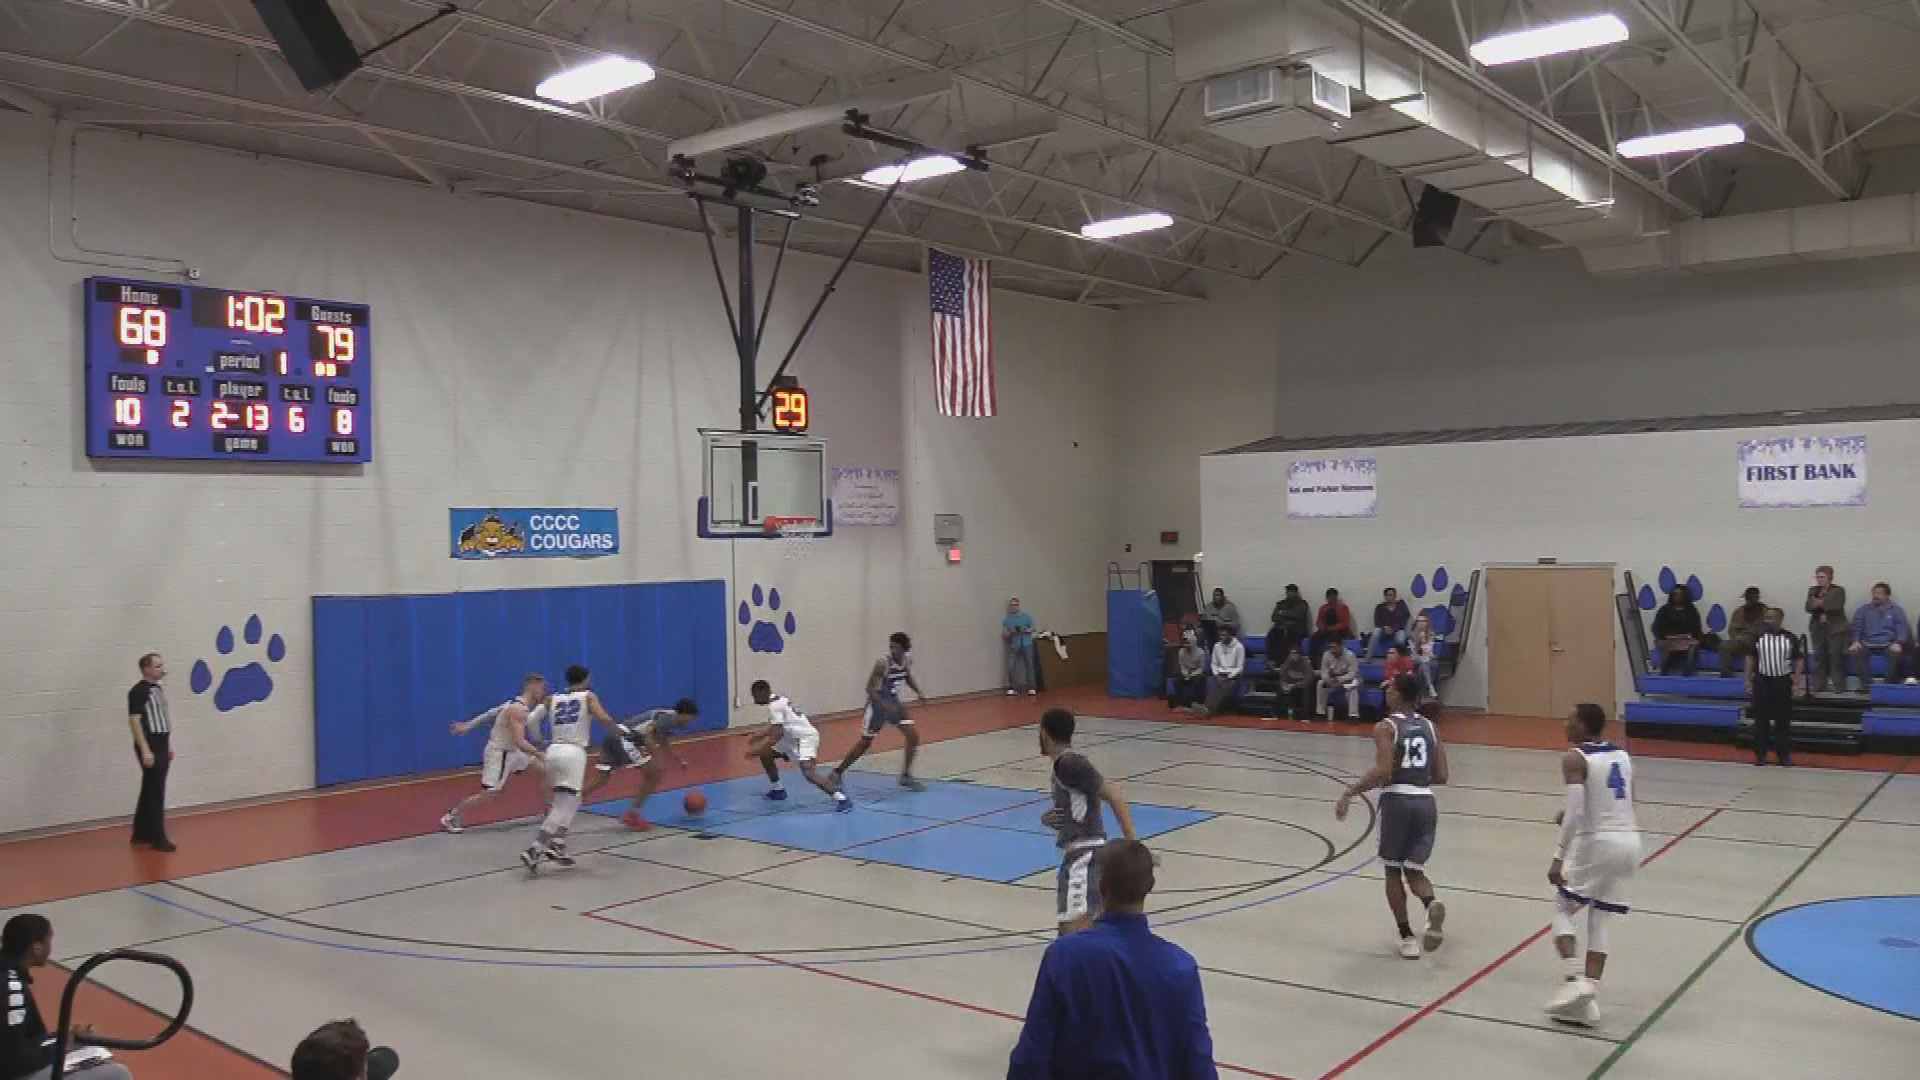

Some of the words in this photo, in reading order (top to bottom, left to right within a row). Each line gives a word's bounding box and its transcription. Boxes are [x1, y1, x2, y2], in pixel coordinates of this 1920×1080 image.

[121, 286, 158, 305] Home
[227, 296, 286, 335] 1:02
[311, 306, 352, 325] Guests
[119, 307, 167, 346] 68
[316, 325, 355, 362] 79
[219, 354, 260, 370] period
[280, 352, 287, 375] 1
[112, 376, 146, 392] fouls
[219, 383, 262, 398] player
[328, 389, 356, 405] fouls
[115, 398, 141, 425] 10
[172, 400, 190, 427] 2
[288, 407, 305, 432] 6
[776, 392, 806, 427] 29
[336, 409, 353, 435] 8
[116, 433, 144, 446] won
[225, 437, 258, 451] game
[332, 440, 354, 453] won
[1747, 465, 1799, 481] FIRST
[1804, 464, 1857, 480] BANK
[530, 515, 579, 530] CCCC
[530, 533, 613, 549] COUGARS
[555, 699, 580, 724] 22
[1401, 736, 1427, 768] 13
[1607, 762, 1626, 800] 4
